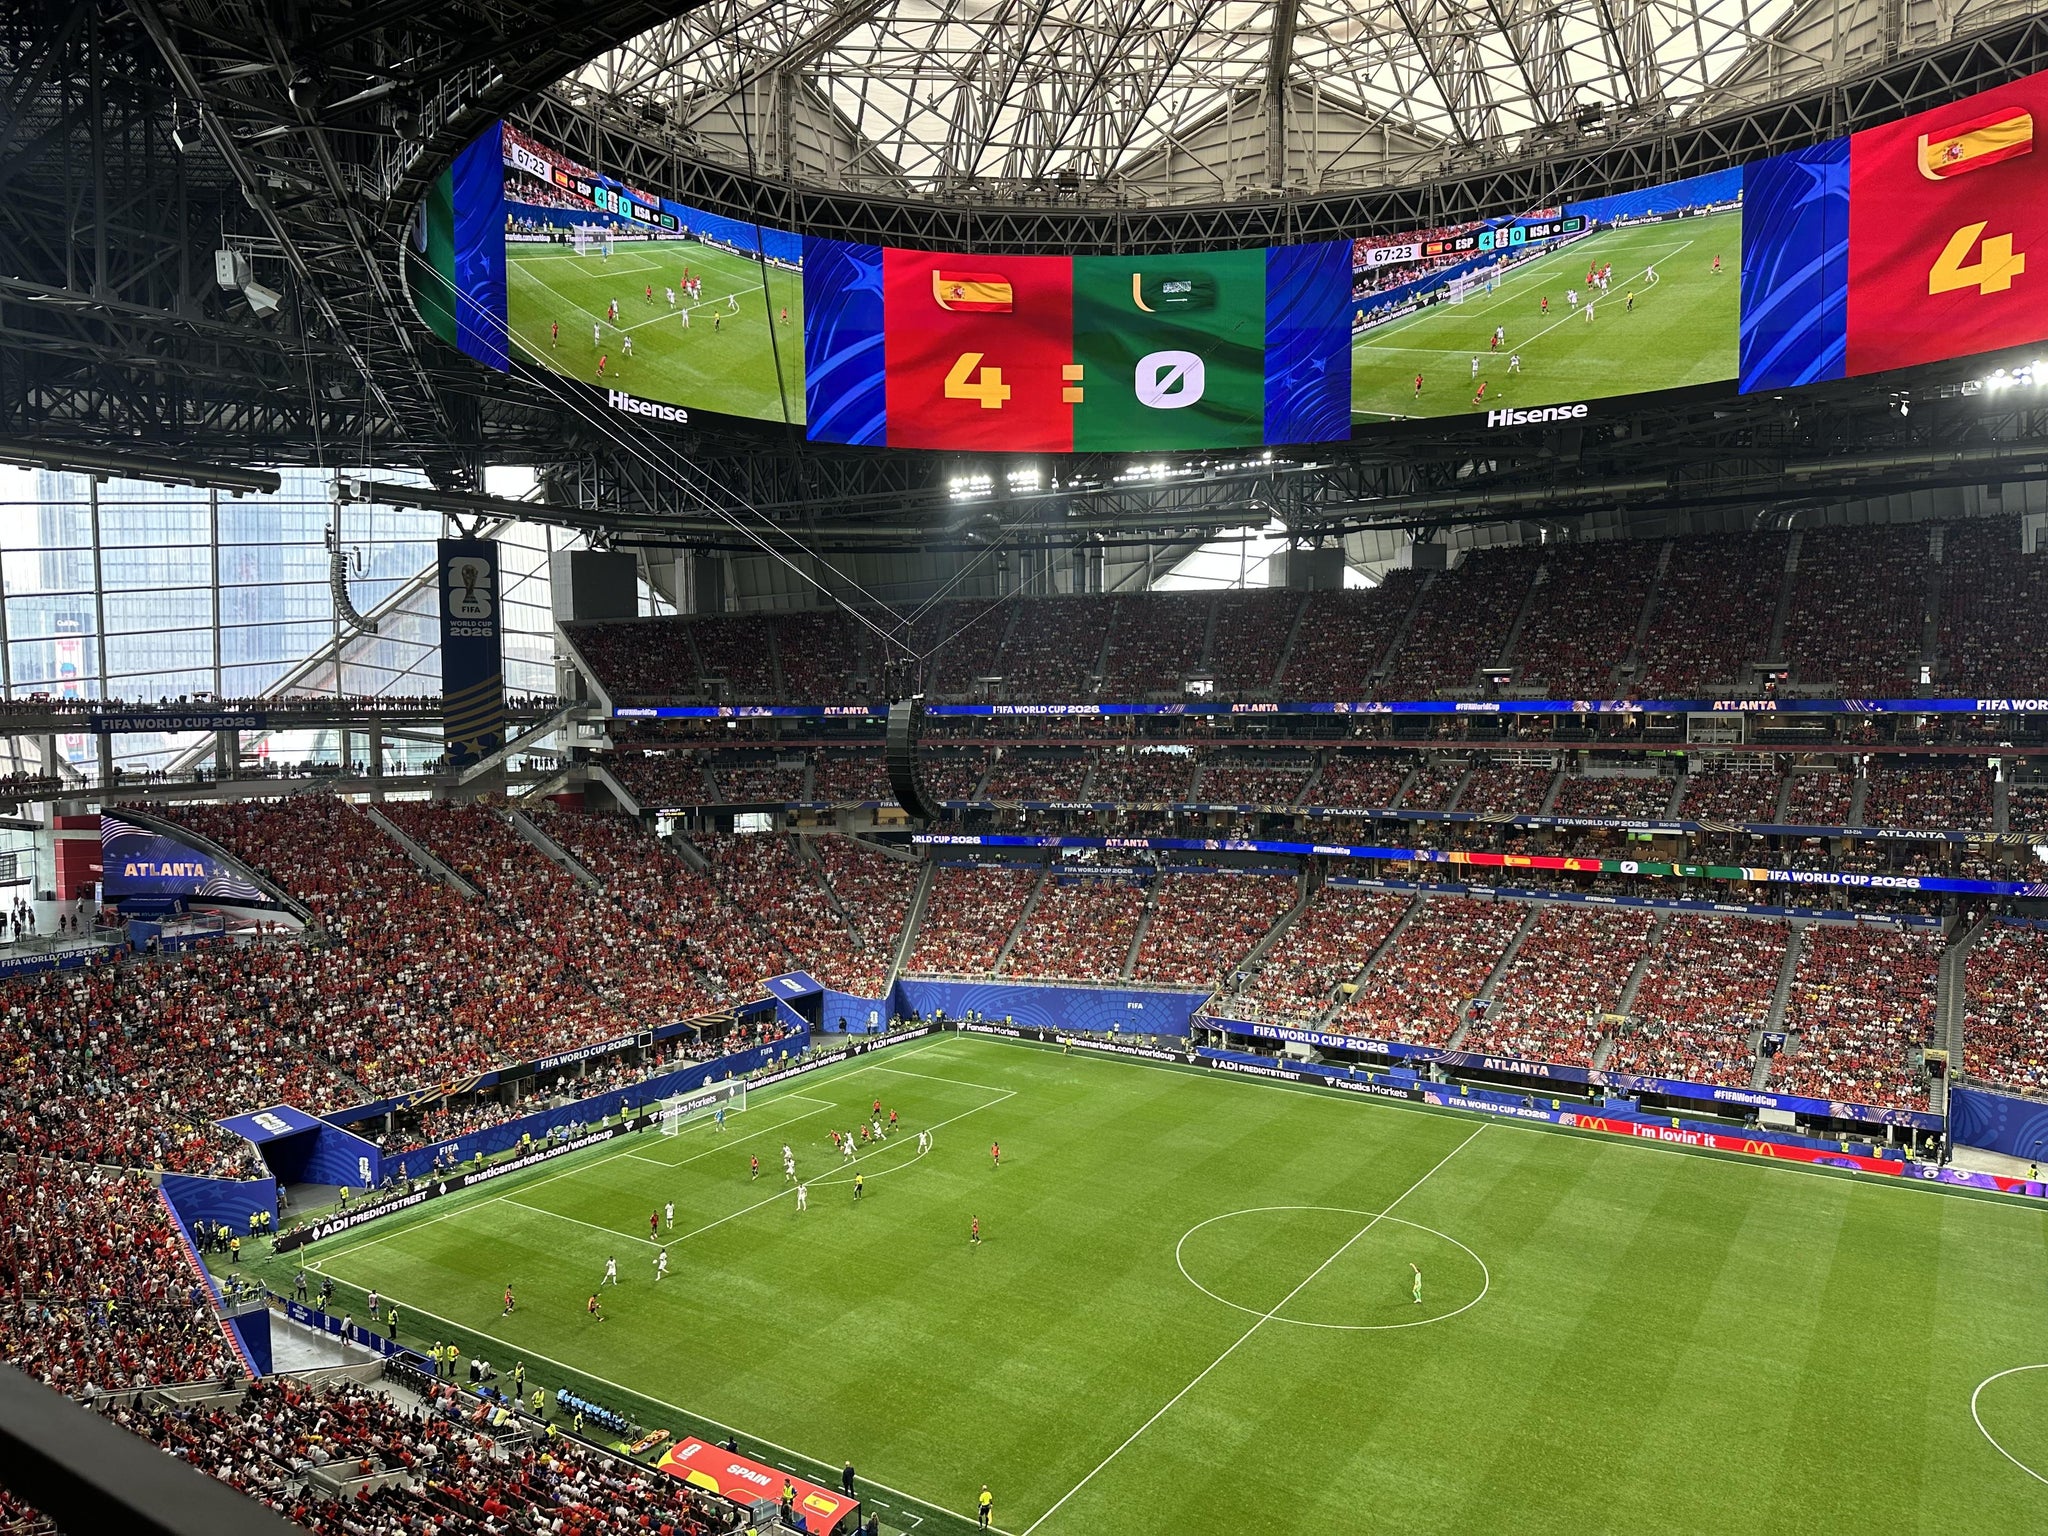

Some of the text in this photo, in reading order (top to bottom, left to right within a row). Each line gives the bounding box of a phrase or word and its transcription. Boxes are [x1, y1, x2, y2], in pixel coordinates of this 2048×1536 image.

[517, 149, 545, 176] 67:23
[577, 180, 650, 221] ESP 4 0 KSA
[1455, 224, 1550, 250] ESP 4 0 KSA
[1374, 246, 1412, 262] 67:23
[1929, 220, 2025, 295] 4
[944, 352, 1011, 409] 4
[1135, 350, 1205, 409] 0
[608, 388, 688, 424] Hisense
[1487, 403, 1588, 428] Hisense
[450, 628, 493, 637] 2026
[824, 706, 869, 715] ATLANTA
[993, 705, 1100, 714] FIFA WORLD CUP 2026
[1232, 703, 1278, 712] ATLANTA
[1713, 700, 1777, 710] ATLANTA
[1977, 700, 2009, 710] FIFA
[101, 716, 256, 730] FIFA WORLD CUP 2026
[1323, 808, 1370, 816] ATLANTA
[933, 835, 950, 844] CUP
[951, 836, 981, 844] 2026
[1105, 839, 1149, 847] ATLANTA
[1877, 830, 1946, 839] ATLANTA
[124, 863, 206, 877] ATLANTA
[1563, 858, 1581, 870] 4
[1767, 870, 1921, 888] FIFA WORLD CUP 2026
[1, 959, 21, 968] FIFA
[22, 955, 55, 965] WORLD
[58, 951, 75, 960] CUP
[1127, 1002, 1144, 1010] FIFA
[967, 1023, 1020, 1037] Fanatics Markets
[872, 1037, 887, 1050] ADI
[1253, 1025, 1390, 1054] FIFA WORLD CUP 2026
[540, 1037, 634, 1070] FIFA WORLD CUP 2026
[760, 1047, 774, 1056] FIFA
[746, 1051, 847, 1091] fanaticsmarkets.com/worldcup
[1218, 1062, 1238, 1072] ADI
[1483, 1058, 1550, 1077] ATLANTA
[1336, 1078, 1408, 1099] Fanatics Markets
[1713, 1089, 1778, 1107] #FIFAWorldCup
[658, 1094, 717, 1121] Fanatics Markets
[1448, 1097, 1548, 1119] FIFA WORLD CUP 2026
[1632, 1122, 1716, 1147] i'm lovin' it
[439, 1142, 460, 1156] FIFA
[463, 1129, 614, 1186] fanaticsmarkets.com/worldcup
[321, 1216, 349, 1237] ADI
[726, 1464, 772, 1487] SPAIN
